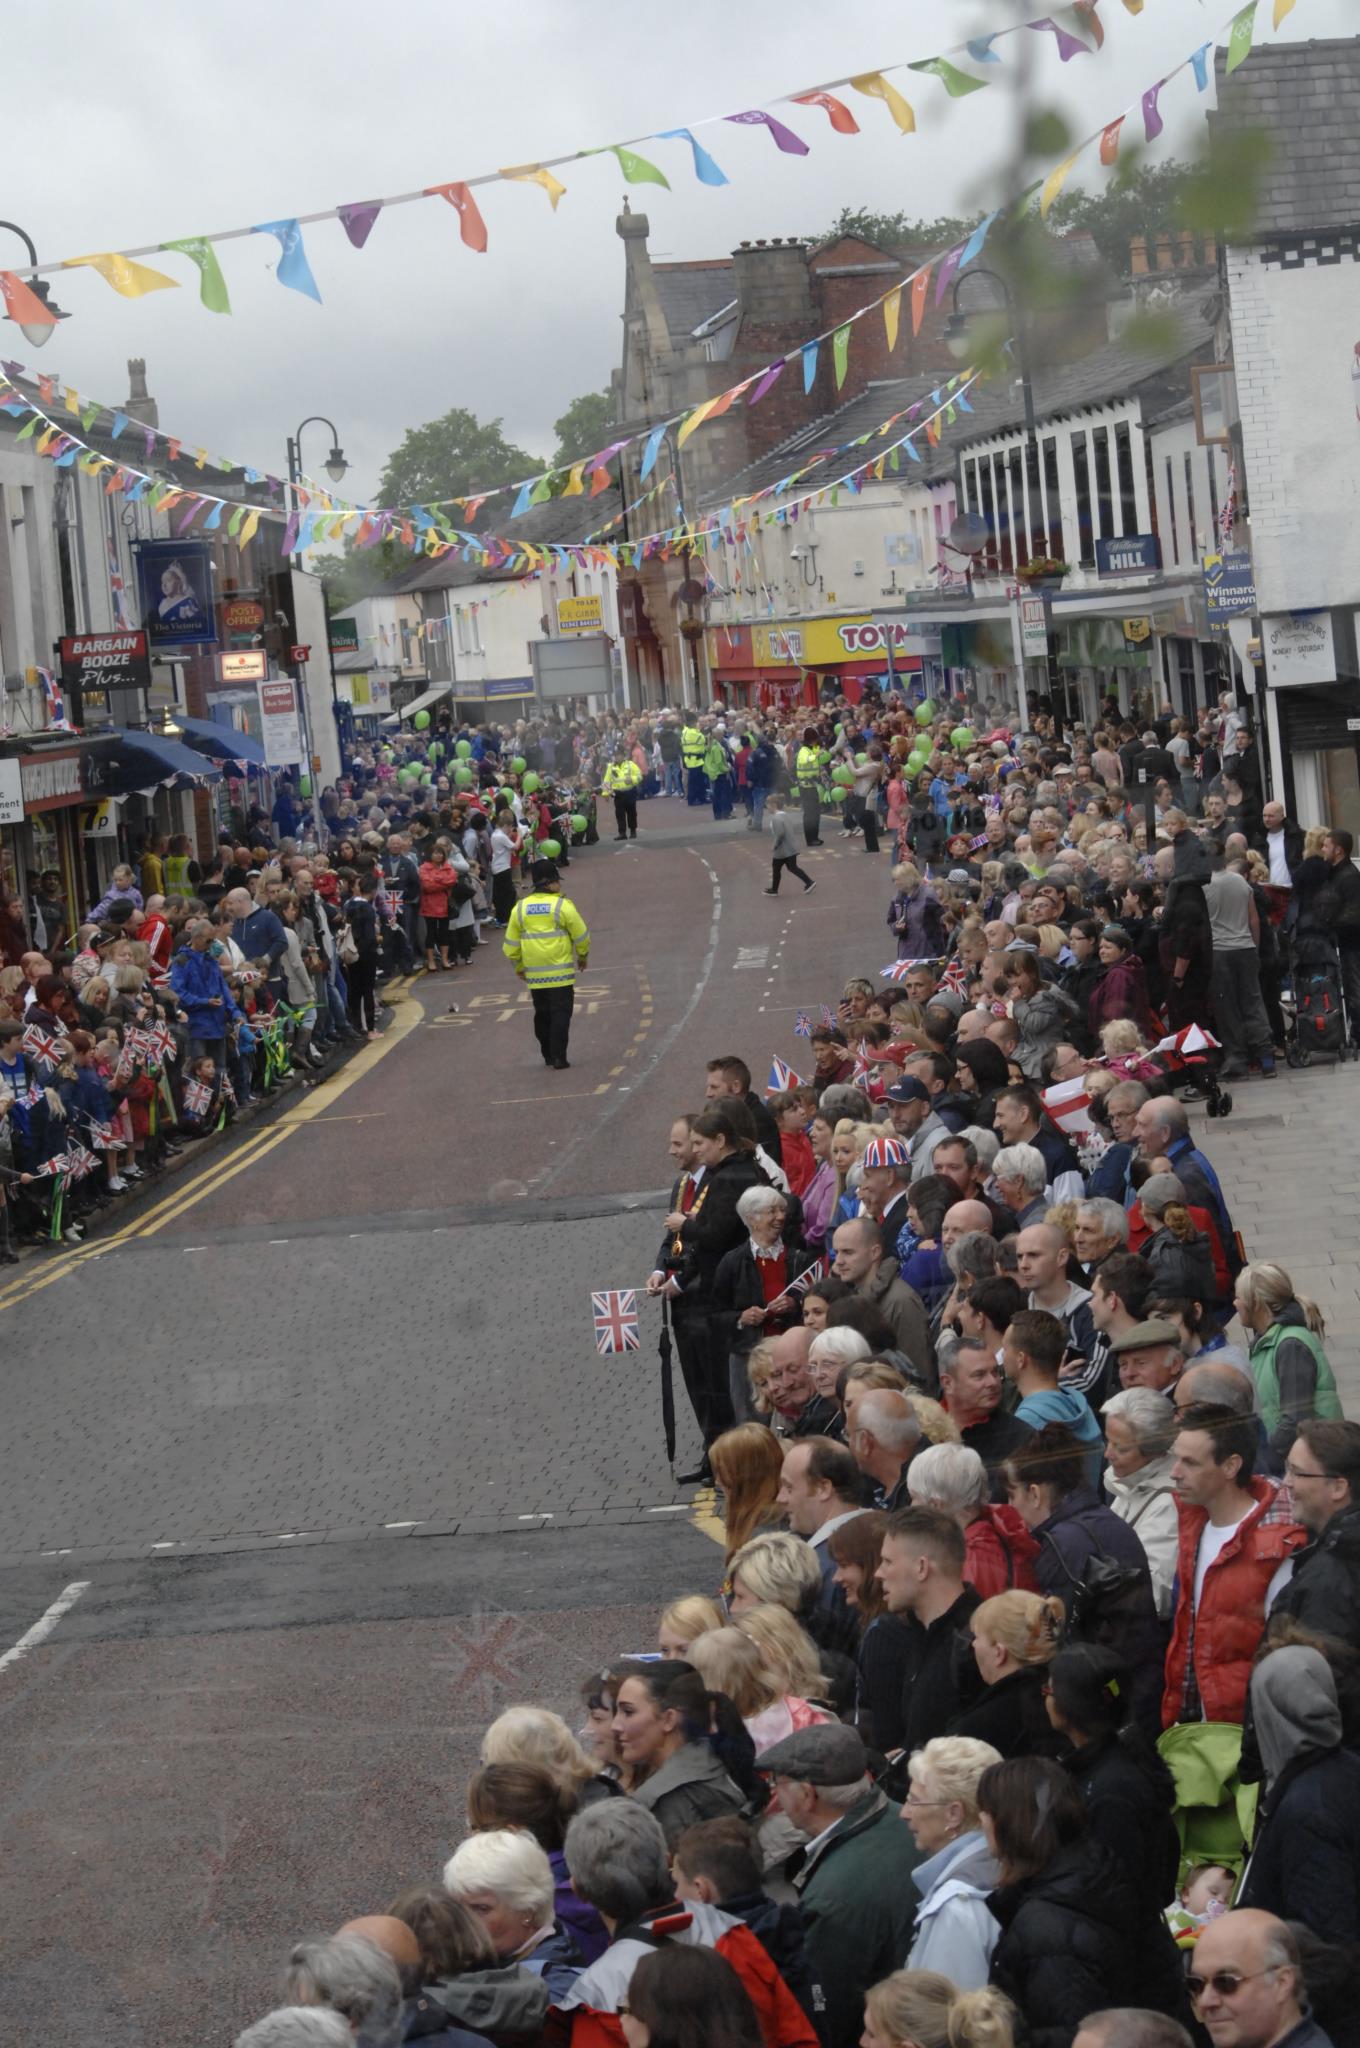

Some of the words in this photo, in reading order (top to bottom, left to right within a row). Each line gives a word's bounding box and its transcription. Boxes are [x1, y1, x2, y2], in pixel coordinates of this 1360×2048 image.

[1109, 552, 1145, 570] HILL
[1207, 585, 1255, 597] Winnard
[1208, 597, 1216, 608] &
[1219, 596, 1256, 606] Brown
[230, 606, 255, 616] POST
[154, 623, 169, 631] The
[172, 622, 202, 630] Victoria
[226, 616, 260, 626] OFFICE
[1210, 623, 1220, 631] To
[1303, 621, 1327, 640] HOURS
[72, 637, 137, 654] BARGAIN
[1272, 647, 1292, 656] MONDAY
[1298, 644, 1325, 653] SATURDAY
[294, 649, 305, 660] G
[81, 653, 131, 669] BOOZE
[79, 670, 136, 686] Plus...
